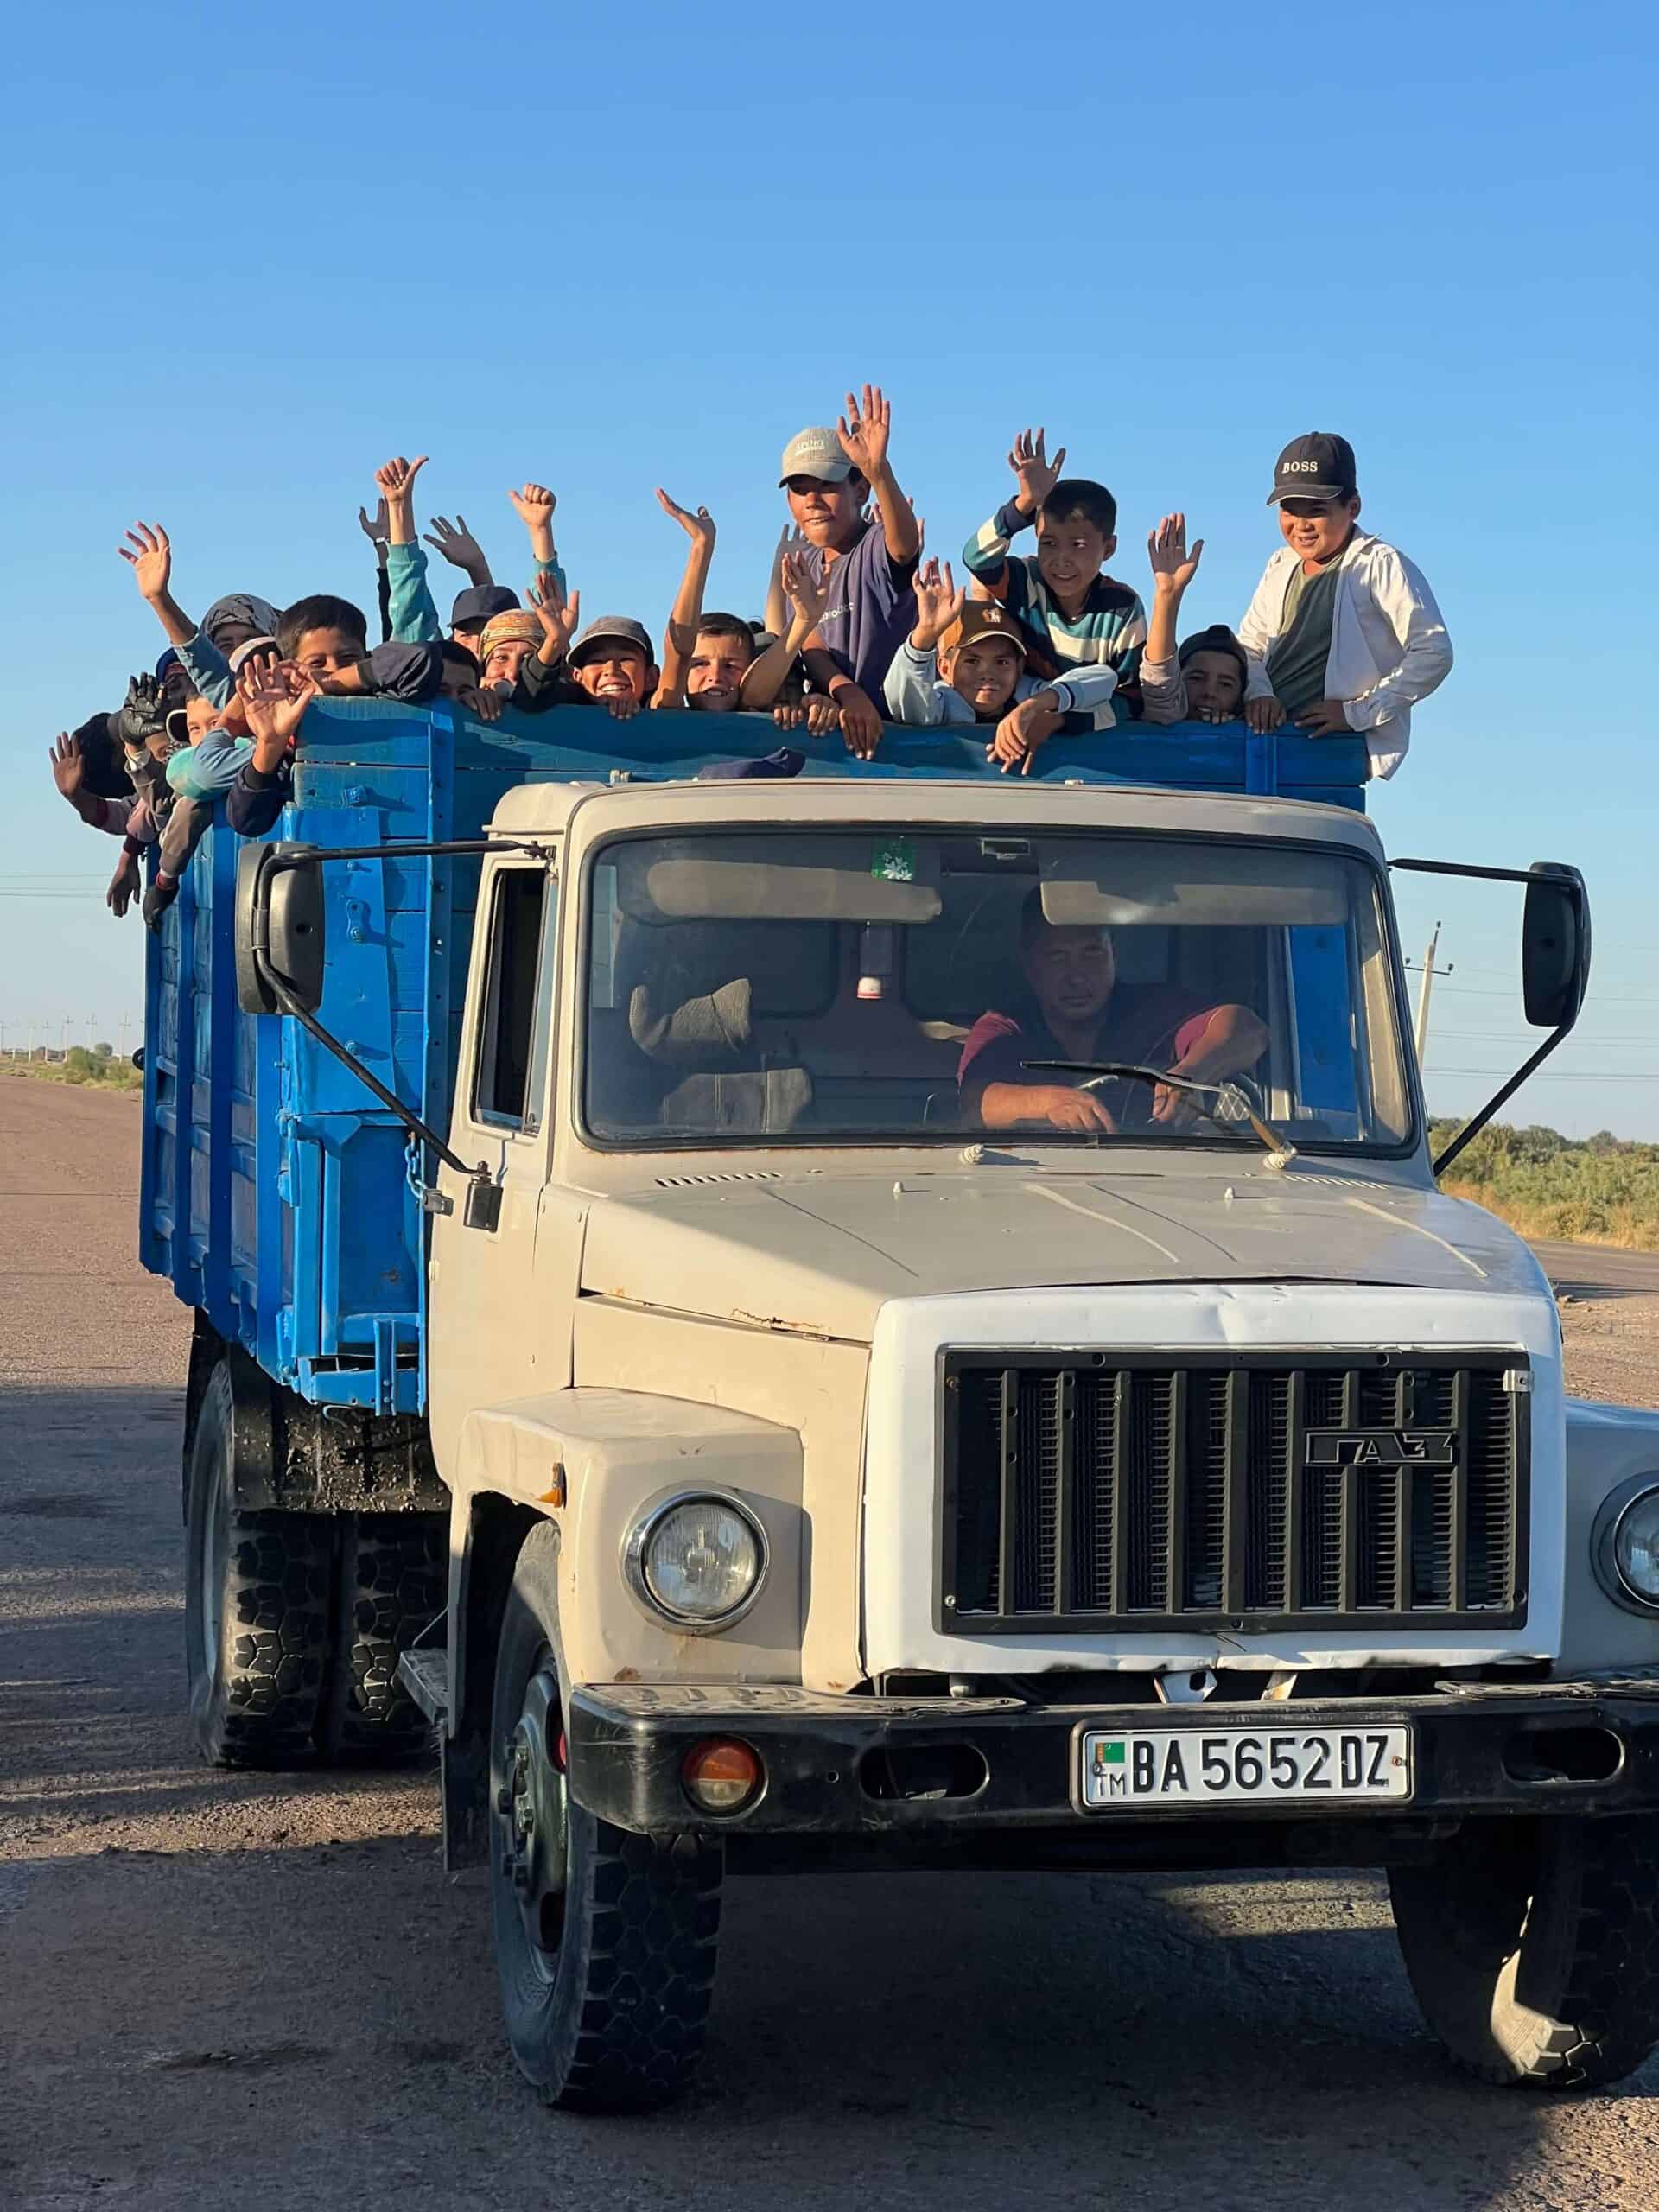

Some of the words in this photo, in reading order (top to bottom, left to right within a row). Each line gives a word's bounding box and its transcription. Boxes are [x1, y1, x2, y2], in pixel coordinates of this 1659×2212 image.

[1281, 461, 1319, 474] BOSS
[1306, 1431, 1456, 1465] ГАЗ
[1132, 1739, 1189, 1793] BA
[1201, 1736, 1332, 1791] 5652
[1340, 1734, 1389, 1789] DZ
[1095, 1772, 1127, 1796] TM
